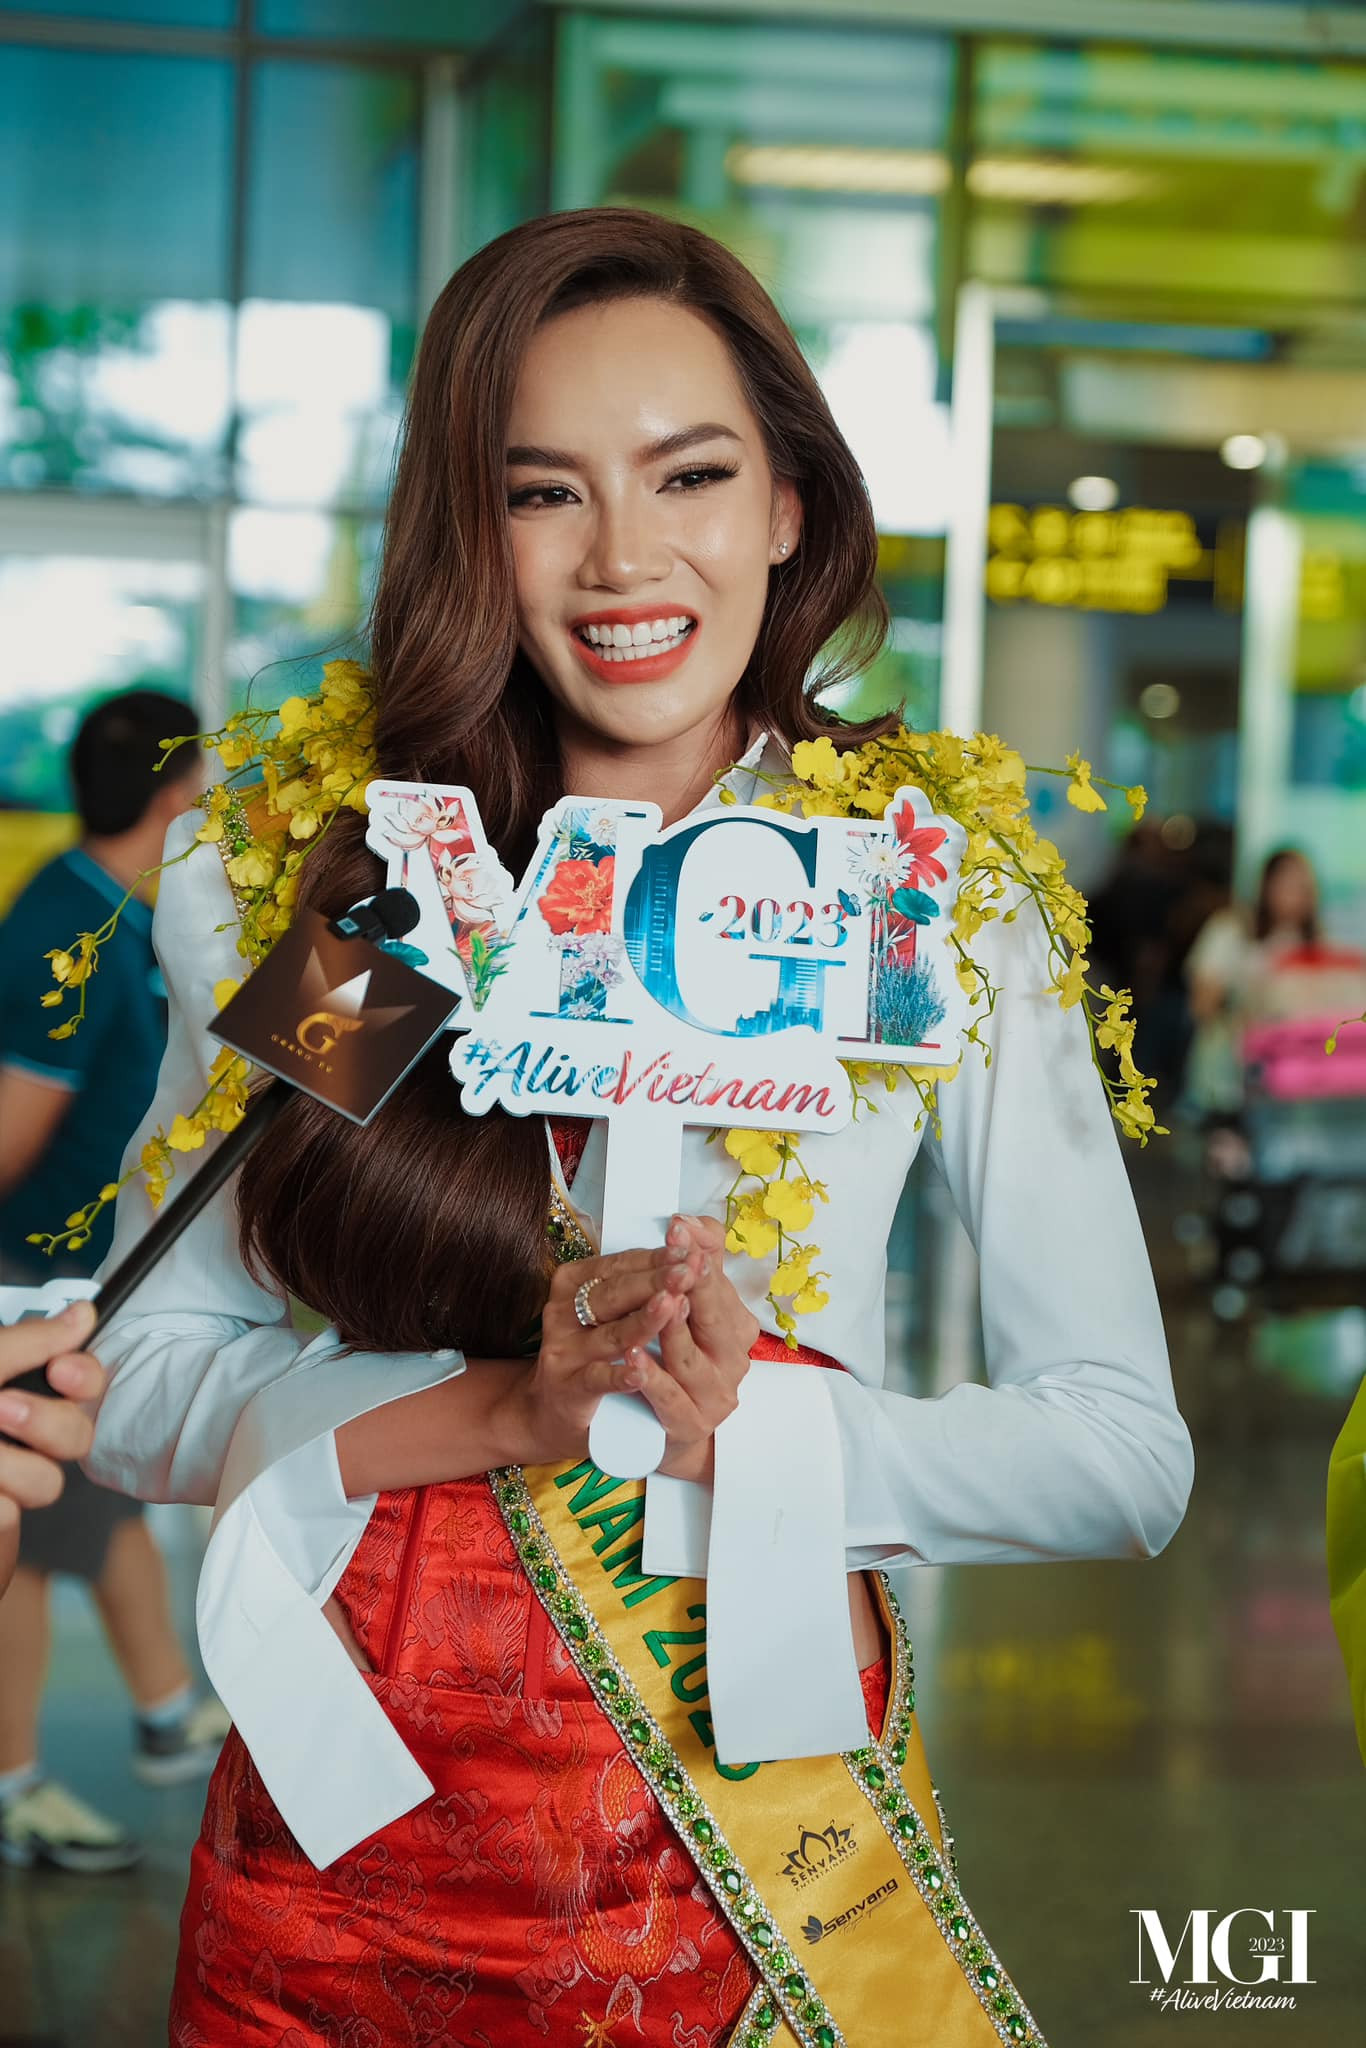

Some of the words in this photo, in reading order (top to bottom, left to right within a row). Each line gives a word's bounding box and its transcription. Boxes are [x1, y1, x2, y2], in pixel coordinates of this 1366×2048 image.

[379, 790, 944, 1049] MGI
[718, 894, 848, 948] 2023
[462, 1039, 836, 1117] #AliveVietnam
[791, 1840, 857, 1887] SENVANG
